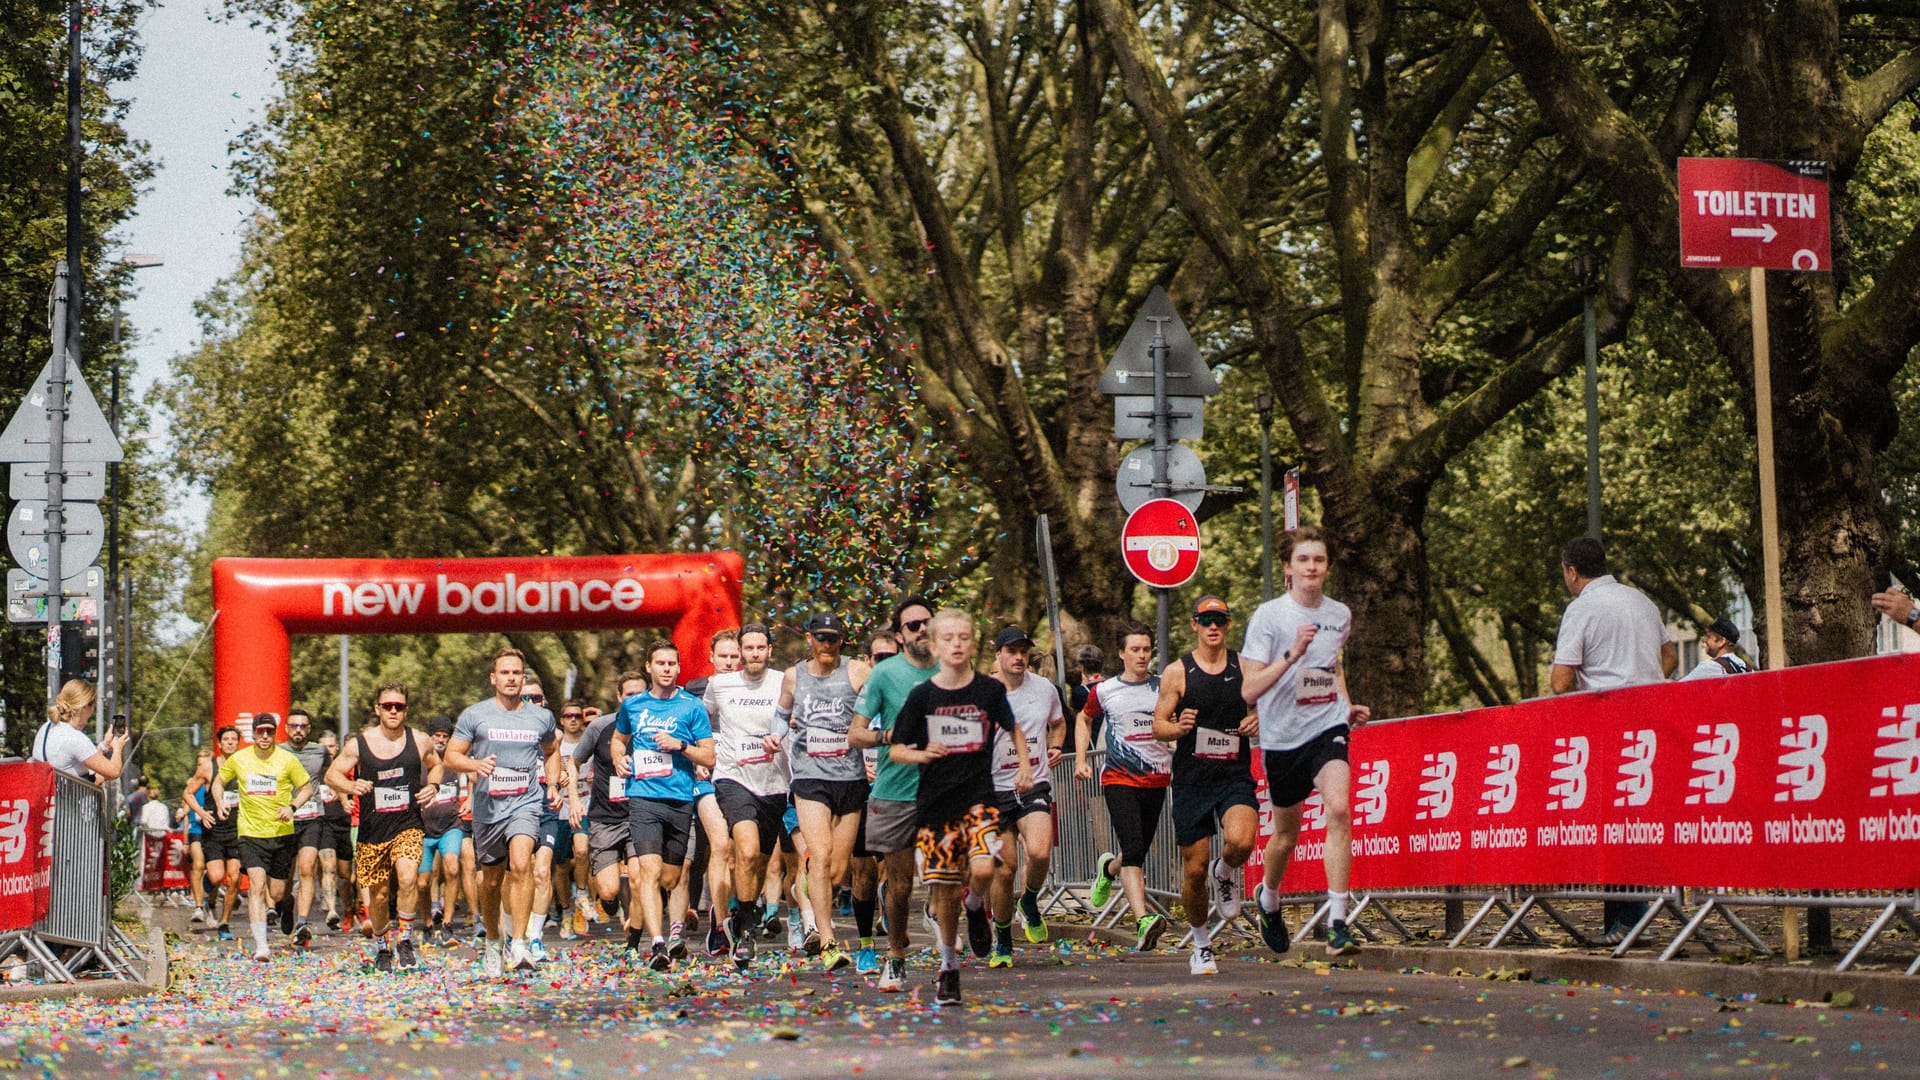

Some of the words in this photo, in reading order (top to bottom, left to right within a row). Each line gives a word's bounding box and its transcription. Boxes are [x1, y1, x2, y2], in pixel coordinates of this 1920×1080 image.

[1693, 190, 1816, 219] TOILETTEN
[322, 582, 426, 616] new
[437, 573, 645, 614] balance
[1303, 676, 1334, 688] Philipp
[738, 698, 774, 707] TERREX
[1133, 718, 1153, 727] Sven
[490, 730, 538, 741] Linklaters
[941, 725, 969, 736] Mats
[809, 734, 848, 744] Alexander
[1207, 736, 1231, 747] Mats
[741, 742, 764, 751] Fabia
[1006, 747, 1032, 757] Jos
[643, 755, 664, 766] 1526
[251, 779, 273, 788] Robert
[491, 773, 528, 783] Hermann
[383, 792, 402, 802] Felix
[1603, 823, 1624, 844] new
[1626, 817, 1665, 844] balance
[1674, 822, 1699, 844] new
[1701, 816, 1753, 844] balance
[1765, 820, 1790, 844] new
[1792, 813, 1845, 843] balance
[1859, 817, 1887, 842] new
[1889, 808, 1920, 842] bala
[1470, 830, 1488, 849] new
[1489, 824, 1528, 848] balance
[1537, 826, 1558, 847] new
[1560, 820, 1597, 846] balance
[1351, 839, 1363, 857] ew
[1364, 833, 1400, 857] balance
[1409, 834, 1427, 853] new
[1429, 828, 1461, 852] balance
[1307, 838, 1326, 860] bala
